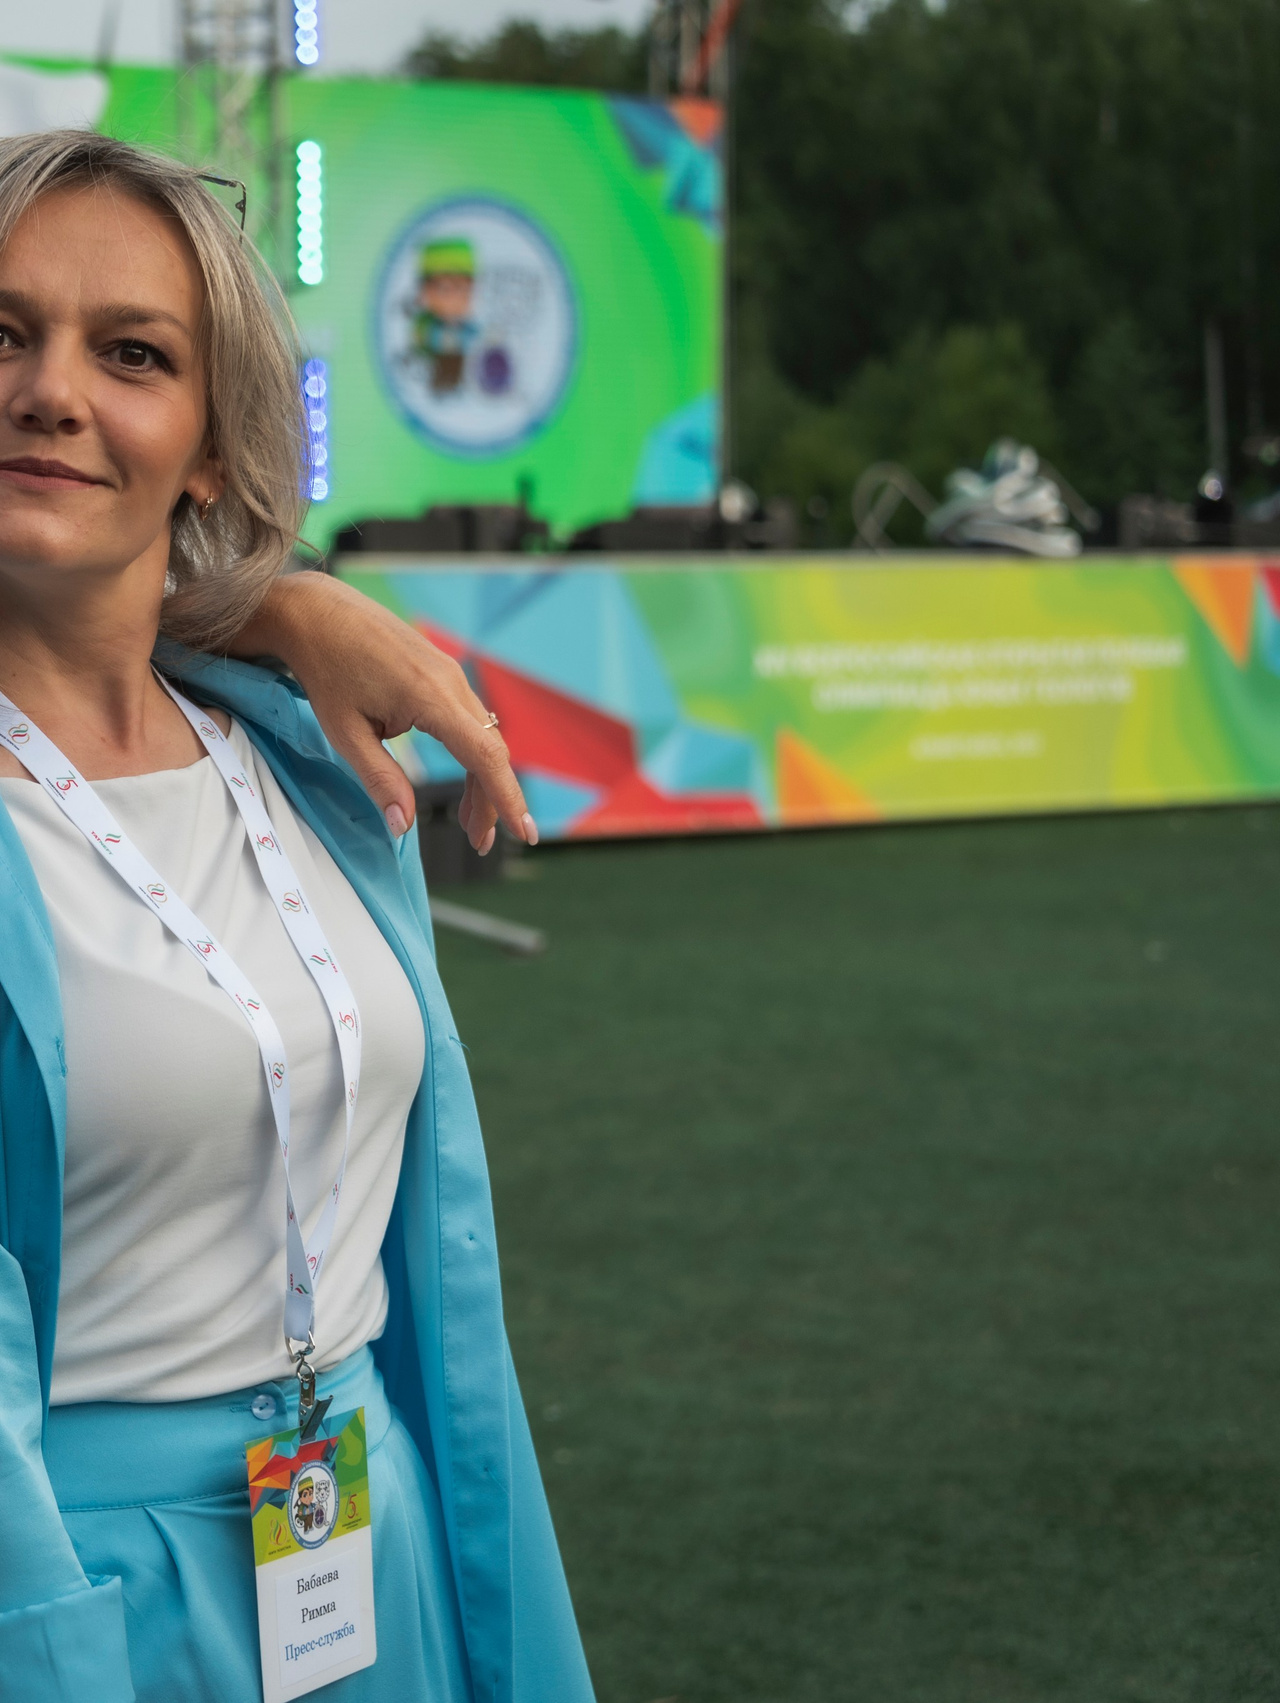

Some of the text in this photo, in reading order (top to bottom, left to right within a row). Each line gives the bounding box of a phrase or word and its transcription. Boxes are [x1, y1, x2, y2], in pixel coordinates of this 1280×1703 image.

[296, 1569, 340, 1595] Бабаева
[301, 1601, 337, 1624] Римма
[284, 1622, 355, 1661] Пресс-служба
